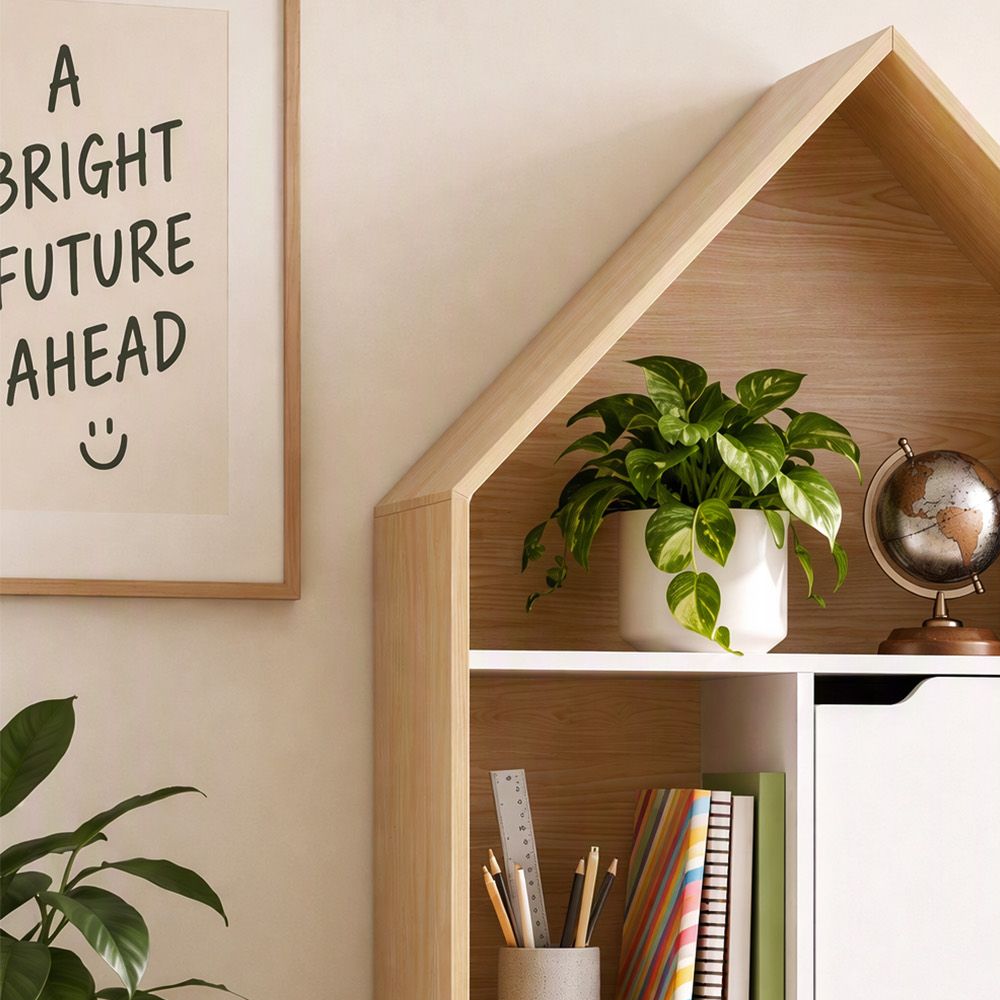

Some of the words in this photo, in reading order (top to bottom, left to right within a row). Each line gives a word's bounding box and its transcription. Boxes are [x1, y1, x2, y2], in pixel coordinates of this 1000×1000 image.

[47, 43, 81, 113] A
[0, 118, 183, 215] BRIGHT
[0, 211, 195, 311] FUTURE
[6, 310, 187, 407] AHEAD
